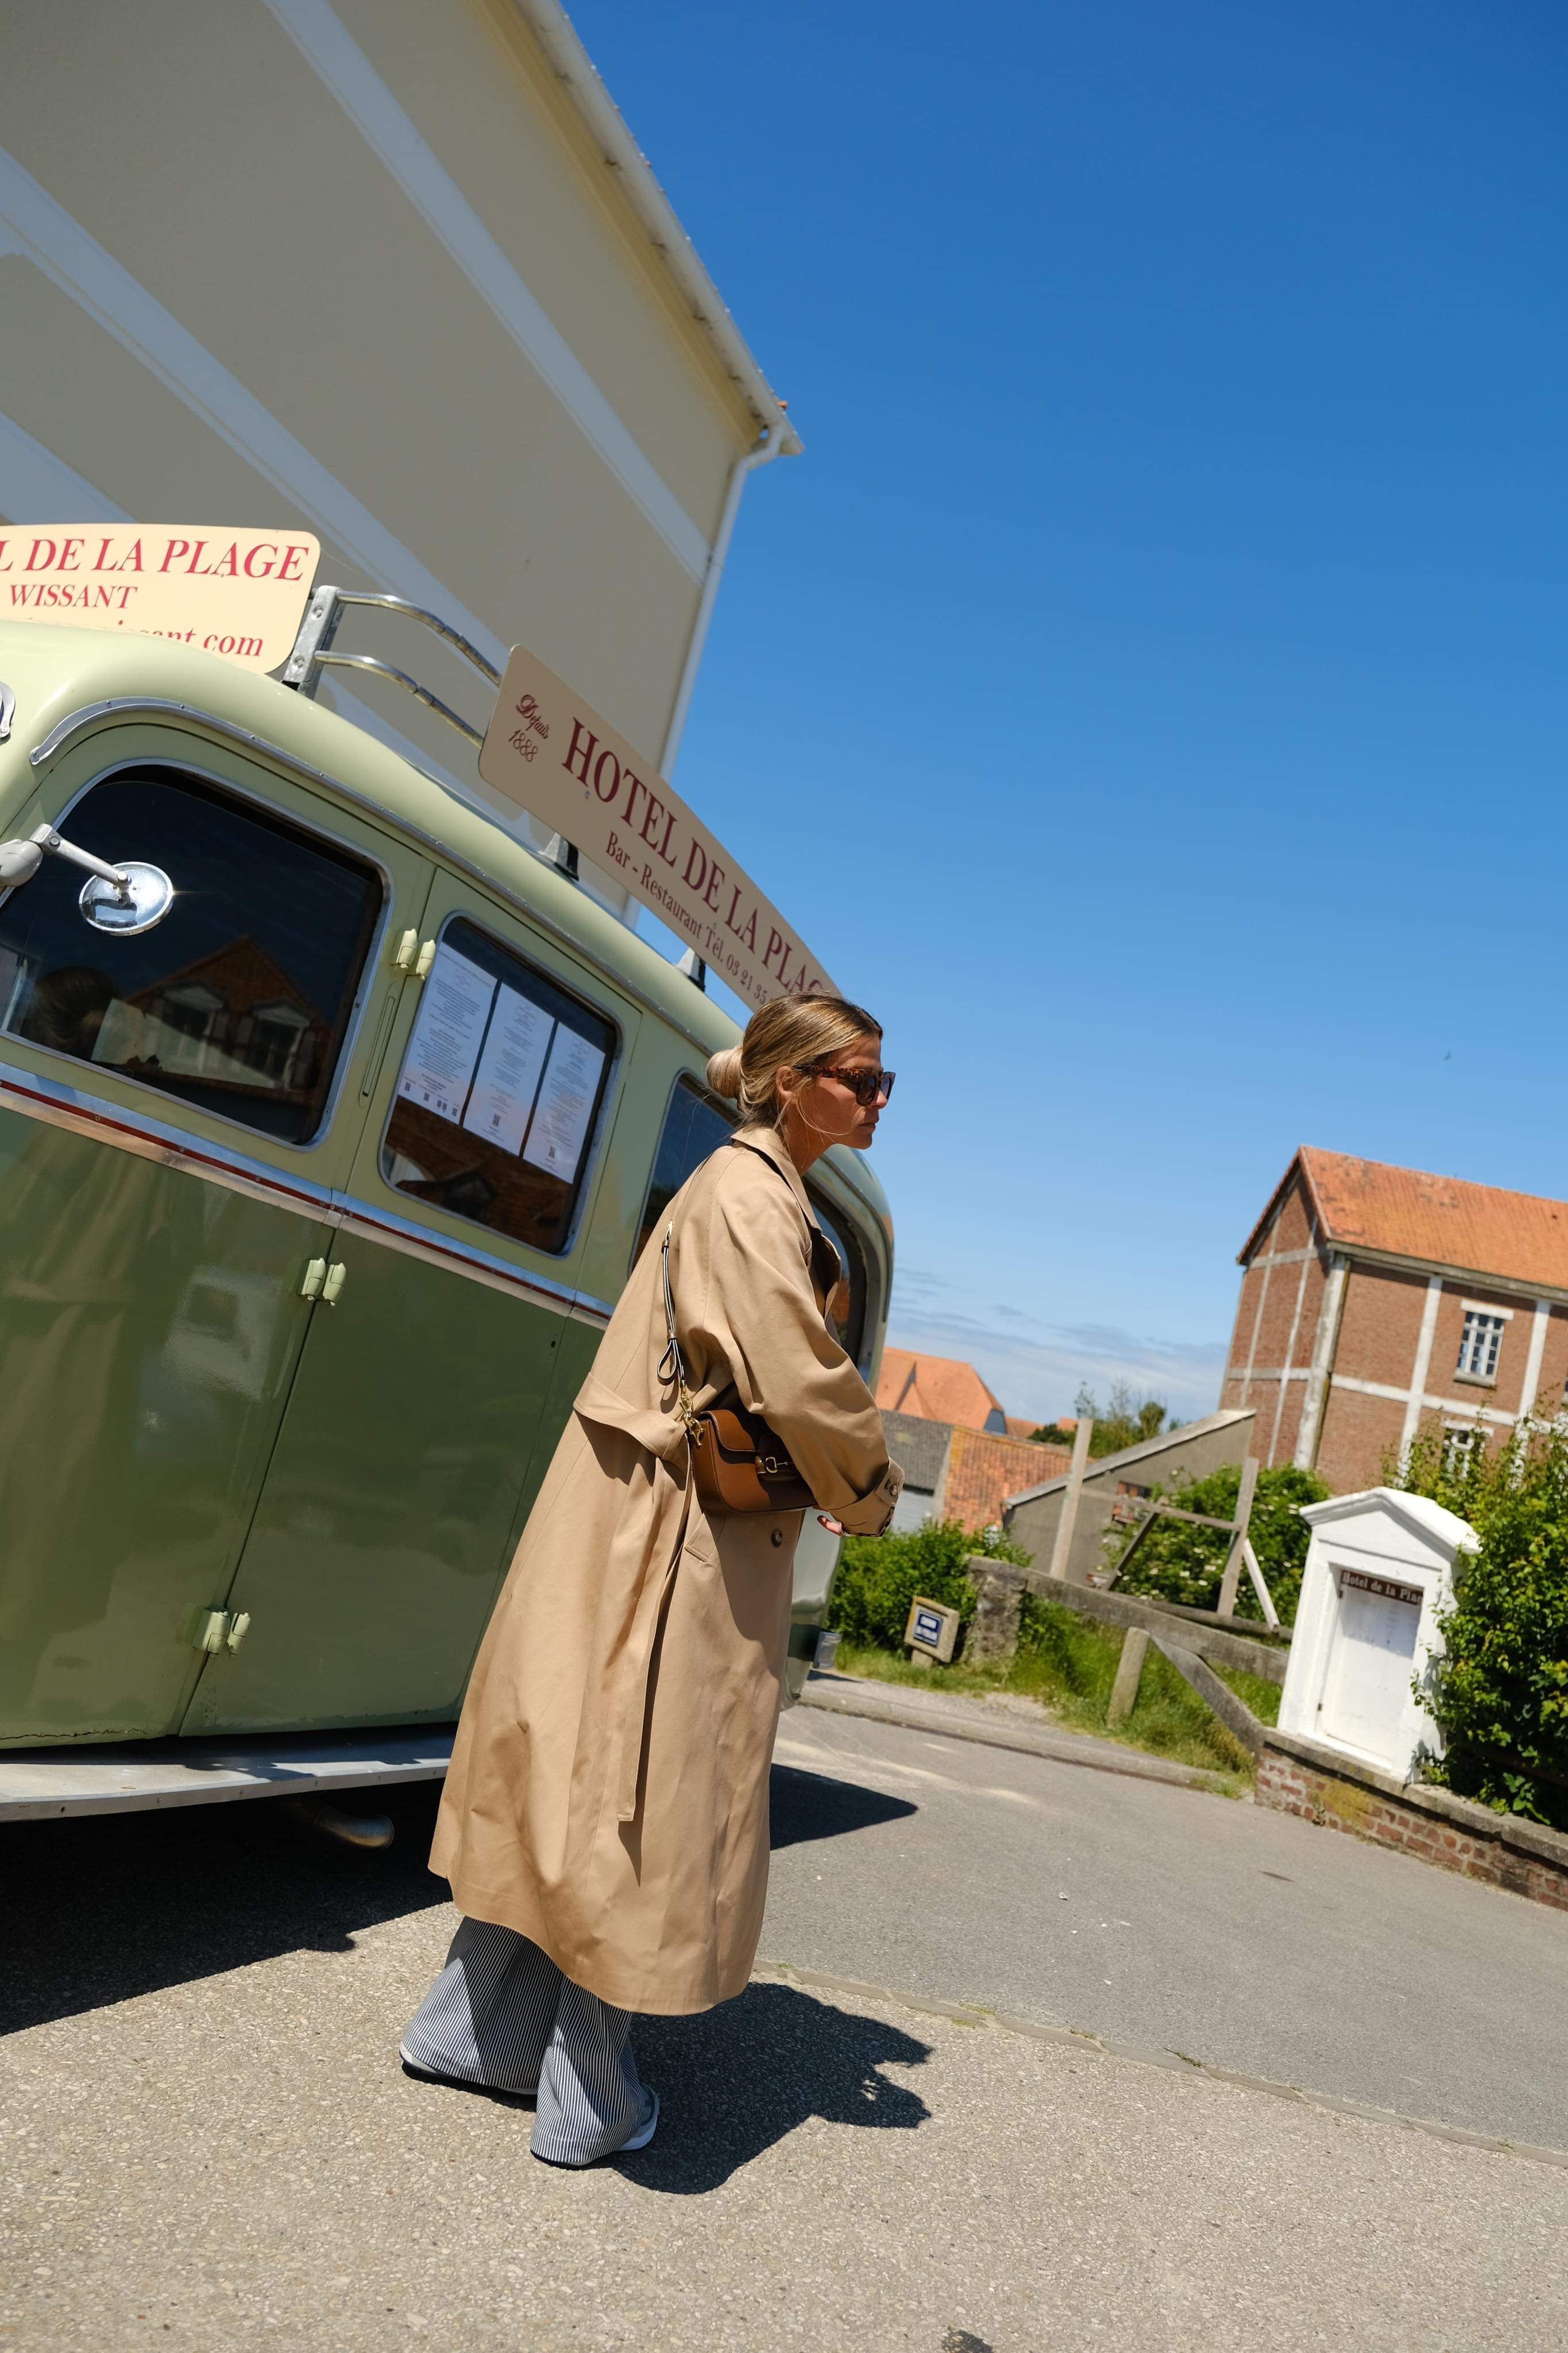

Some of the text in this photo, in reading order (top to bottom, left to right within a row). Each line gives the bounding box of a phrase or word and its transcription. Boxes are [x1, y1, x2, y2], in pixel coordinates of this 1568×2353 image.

[22, 538, 85, 571] DE
[91, 538, 144, 572] LA
[157, 539, 309, 581] PLAGE
[10, 584, 138, 609] WISSANT
[516, 694, 550, 739] Depuis
[508, 729, 539, 762] 1888
[561, 717, 678, 868] HOTEL
[681, 836, 725, 913] DE
[724, 884, 758, 954] LA
[606, 831, 631, 869] Bar
[640, 863, 703, 939] Restaurant
[706, 925, 723, 963] Tél.
[726, 954, 740, 976] 03
[740, 969, 753, 992] 21
[1371, 1580, 1382, 1593] de
[1386, 1584, 1396, 1596] la
